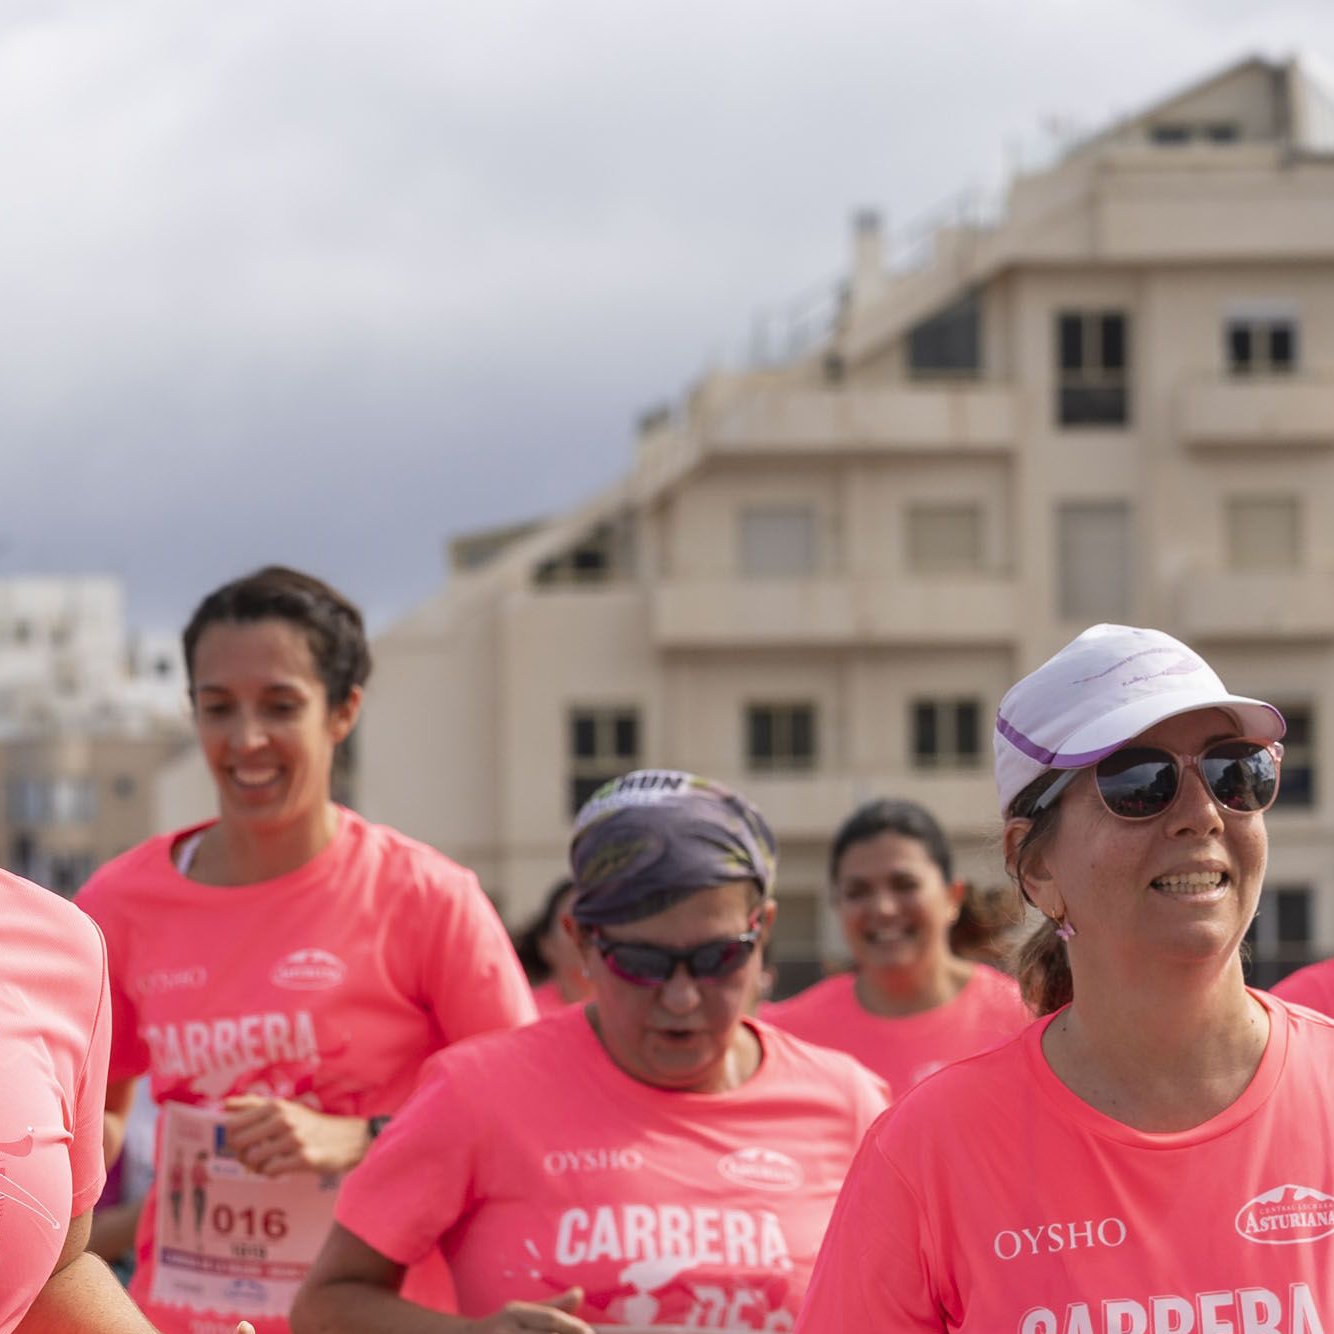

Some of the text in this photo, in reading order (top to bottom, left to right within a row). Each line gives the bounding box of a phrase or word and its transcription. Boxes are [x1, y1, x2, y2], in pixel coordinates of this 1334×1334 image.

[143, 1010, 319, 1077] ARRERA
[543, 1148, 644, 1176] OYSHO
[212, 1203, 288, 1239] 016
[554, 1203, 795, 1272] CARRERA
[994, 1217, 1127, 1260] OYSHO
